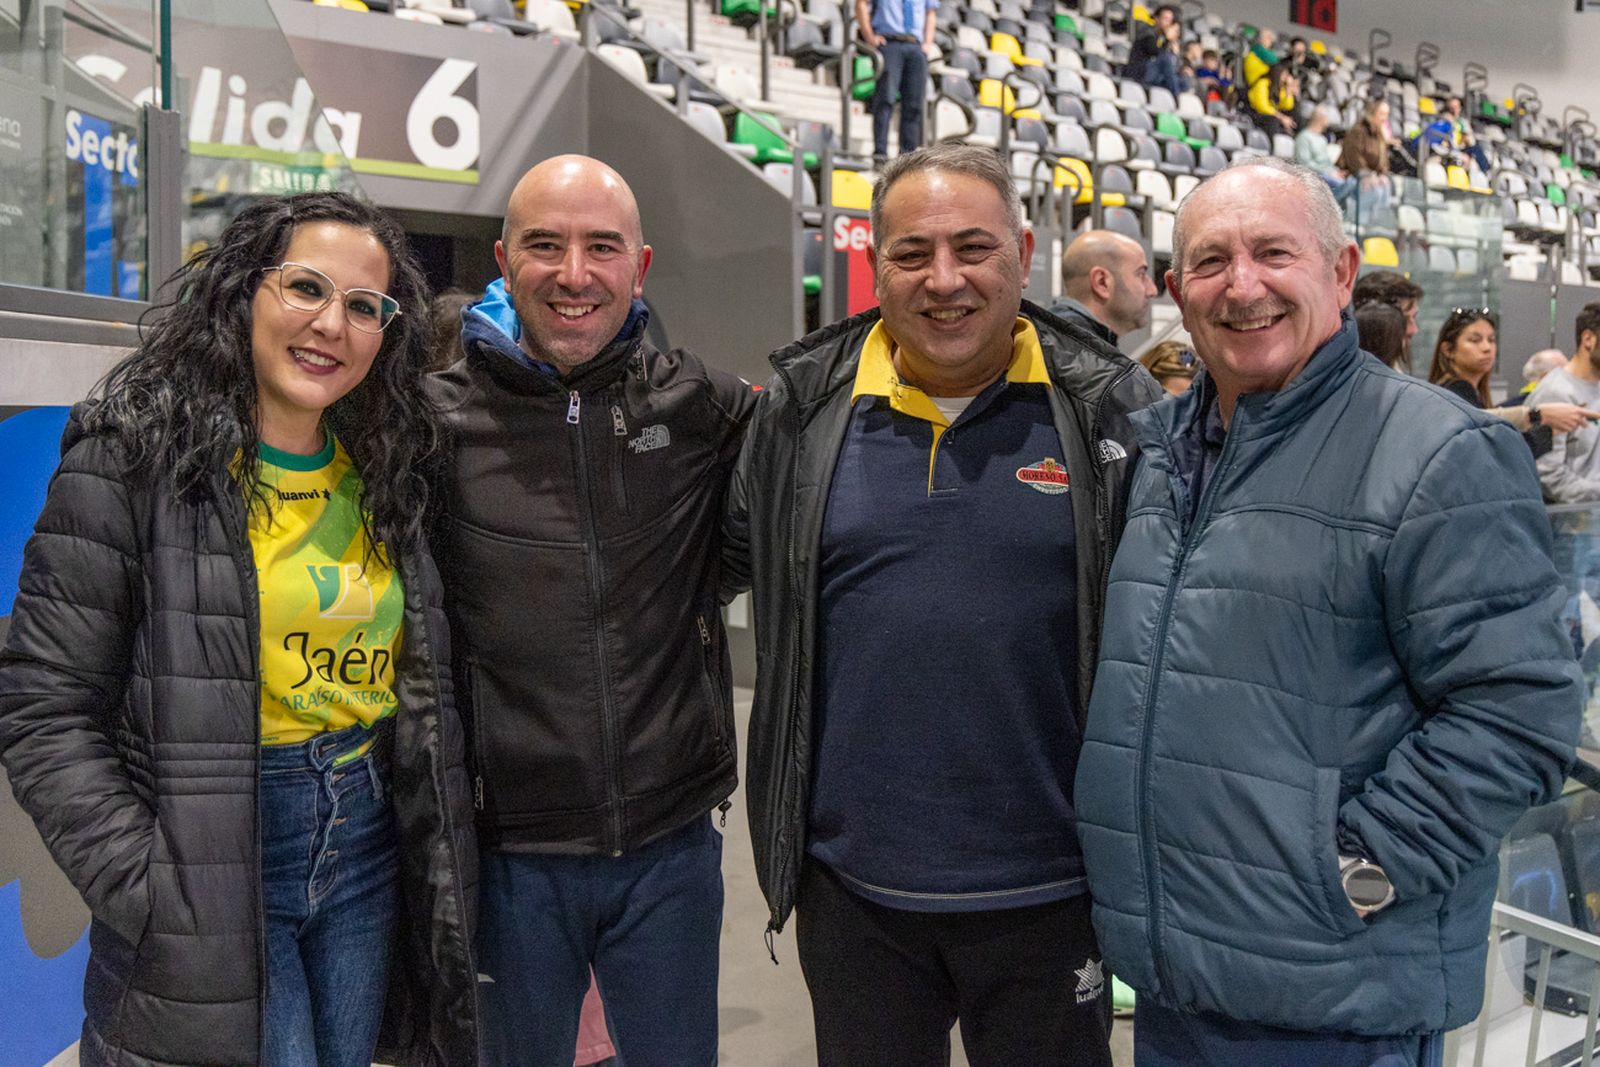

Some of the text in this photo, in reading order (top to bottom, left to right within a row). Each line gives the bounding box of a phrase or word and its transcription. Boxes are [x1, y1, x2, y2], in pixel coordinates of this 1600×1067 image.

[406, 59, 480, 171] 6
[833, 215, 874, 250] Se
[283, 632, 390, 690] Jaén
[280, 685, 343, 711] ARAÍSO
